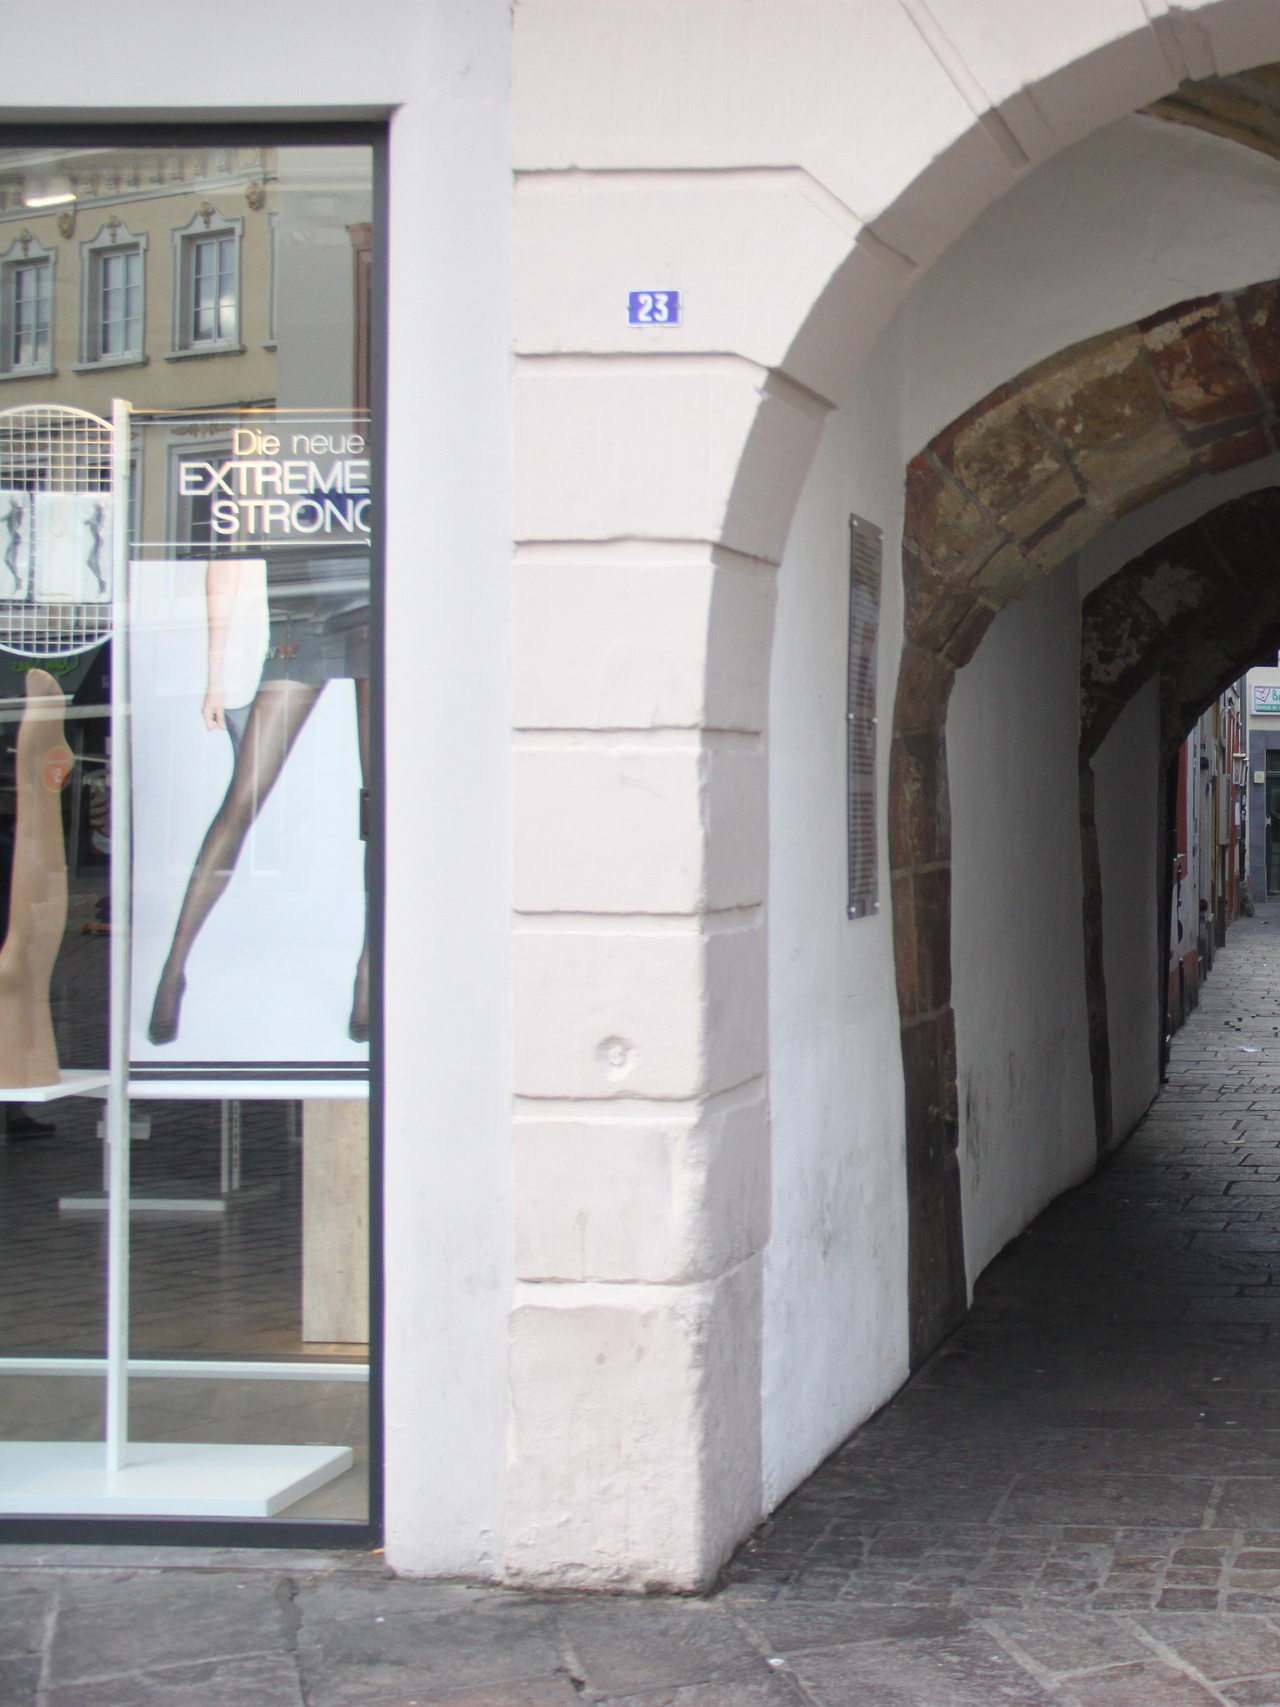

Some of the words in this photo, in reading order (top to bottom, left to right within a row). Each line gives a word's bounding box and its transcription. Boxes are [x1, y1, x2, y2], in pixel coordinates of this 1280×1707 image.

[638, 293, 669, 322] 23
[233, 429, 280, 455] Die
[292, 433, 365, 455] neue
[179, 460, 370, 496] EXTREME
